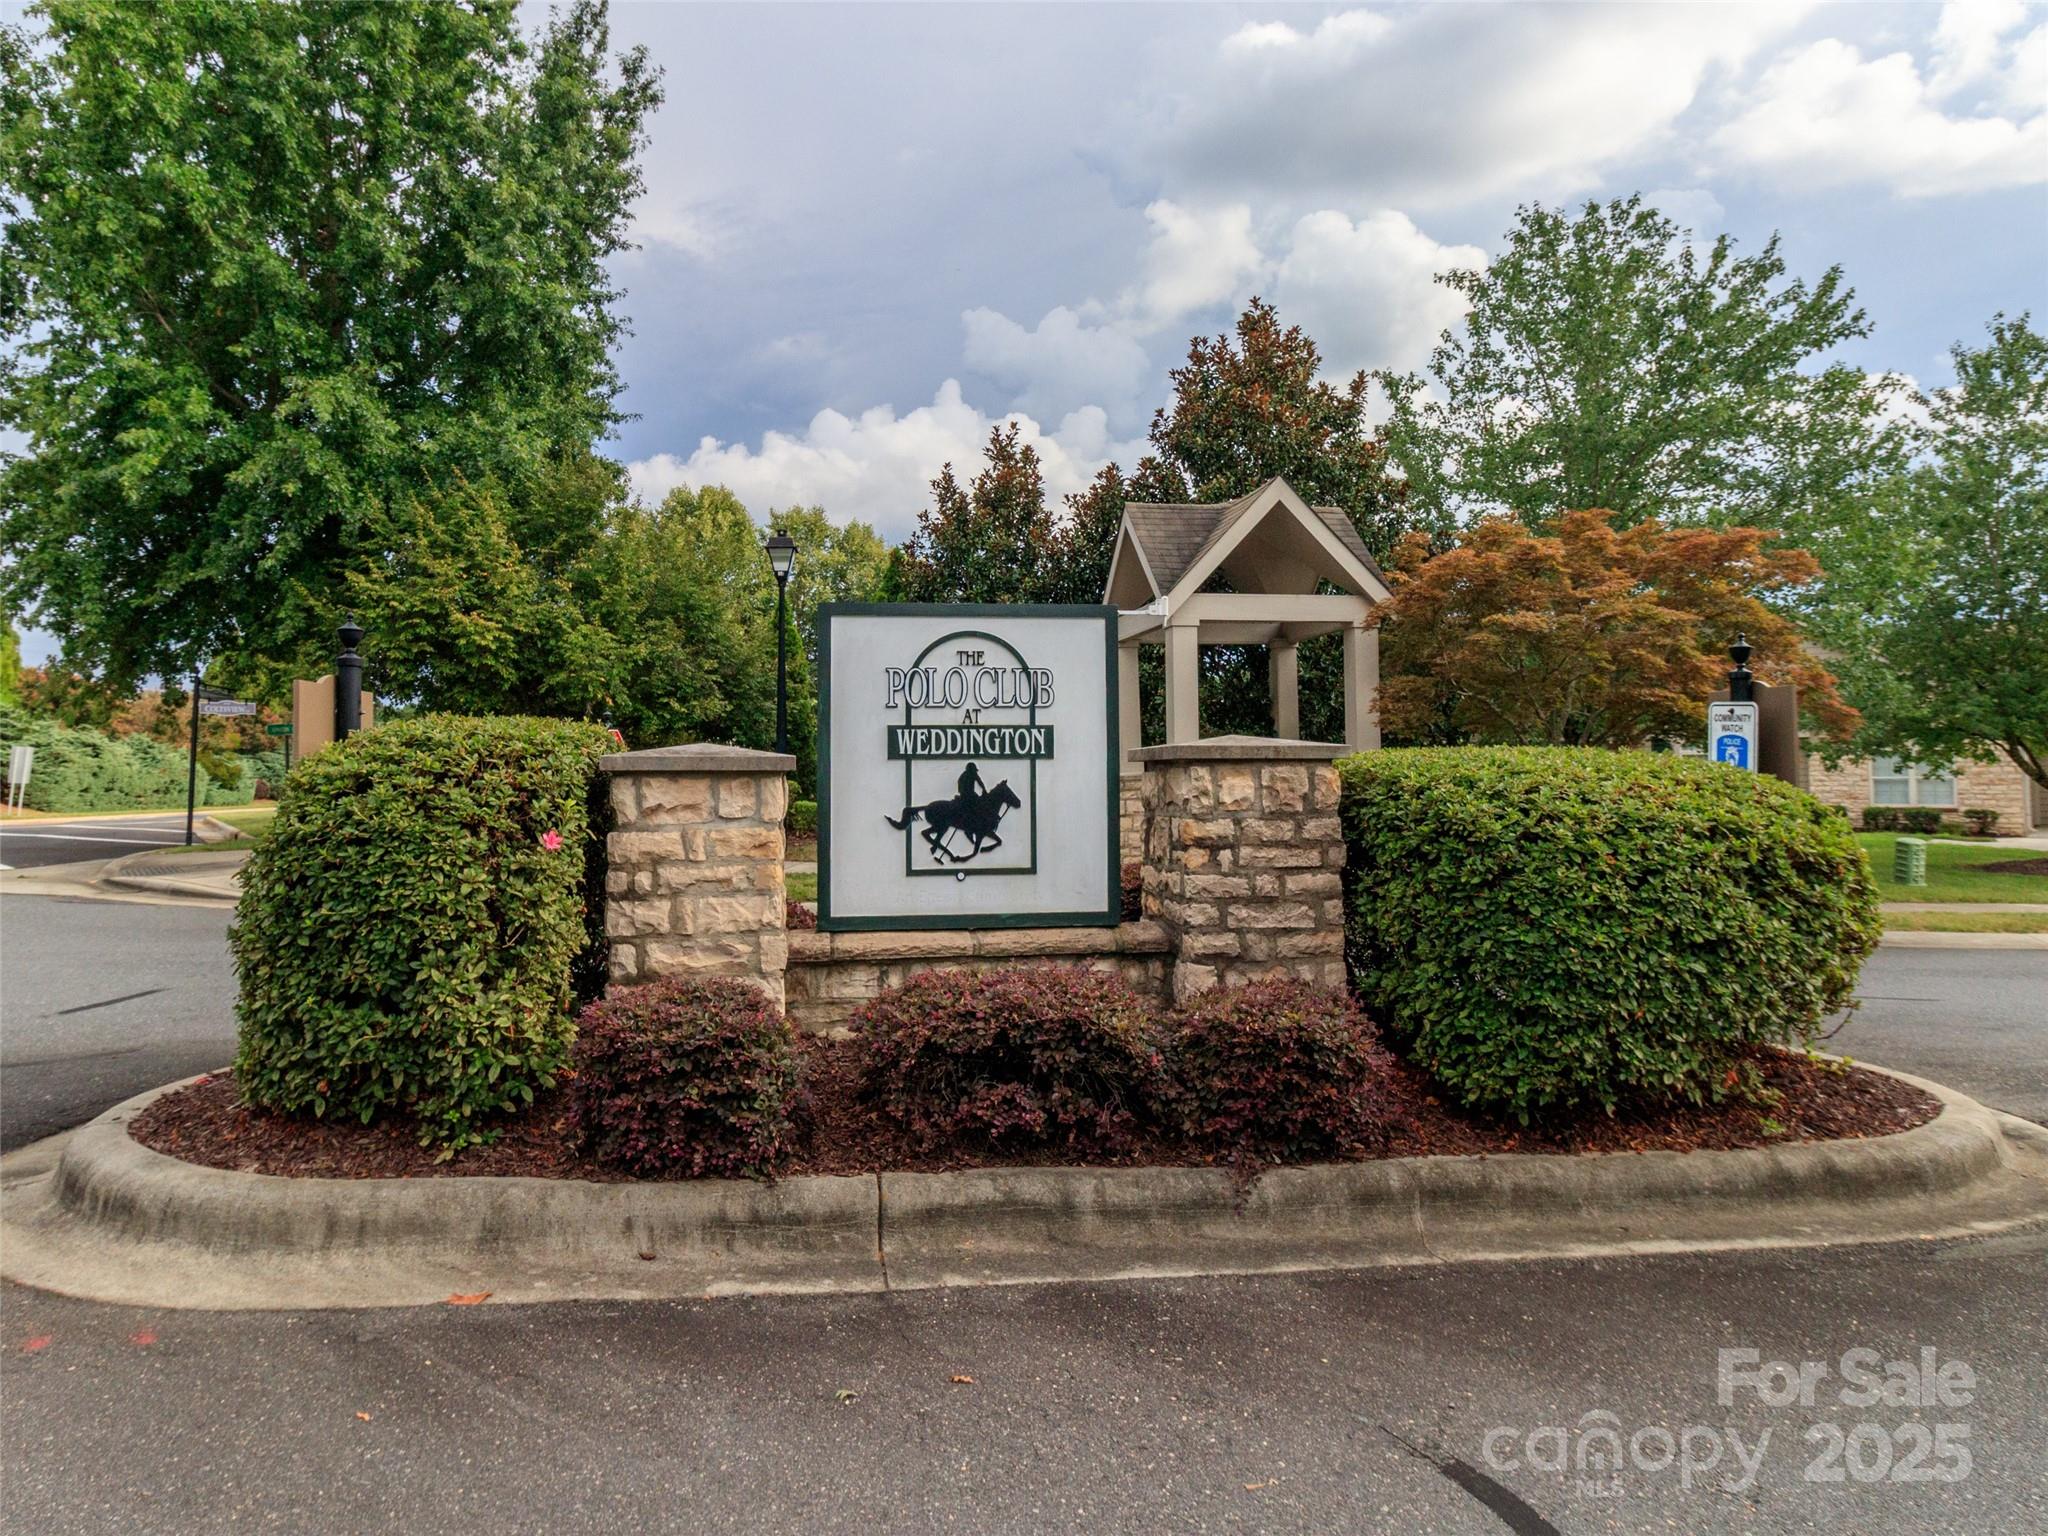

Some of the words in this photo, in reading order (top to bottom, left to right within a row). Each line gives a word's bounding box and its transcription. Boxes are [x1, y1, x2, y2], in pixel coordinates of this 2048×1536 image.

[957, 651, 985, 666] THE
[885, 667, 968, 709] POLO
[973, 667, 1055, 709] CLUB
[962, 709, 981, 724] AT
[1714, 714, 1751, 722] COMMUNITY
[1721, 724, 1743, 732] WATCH
[896, 727, 1046, 755] WEDDINGTON
